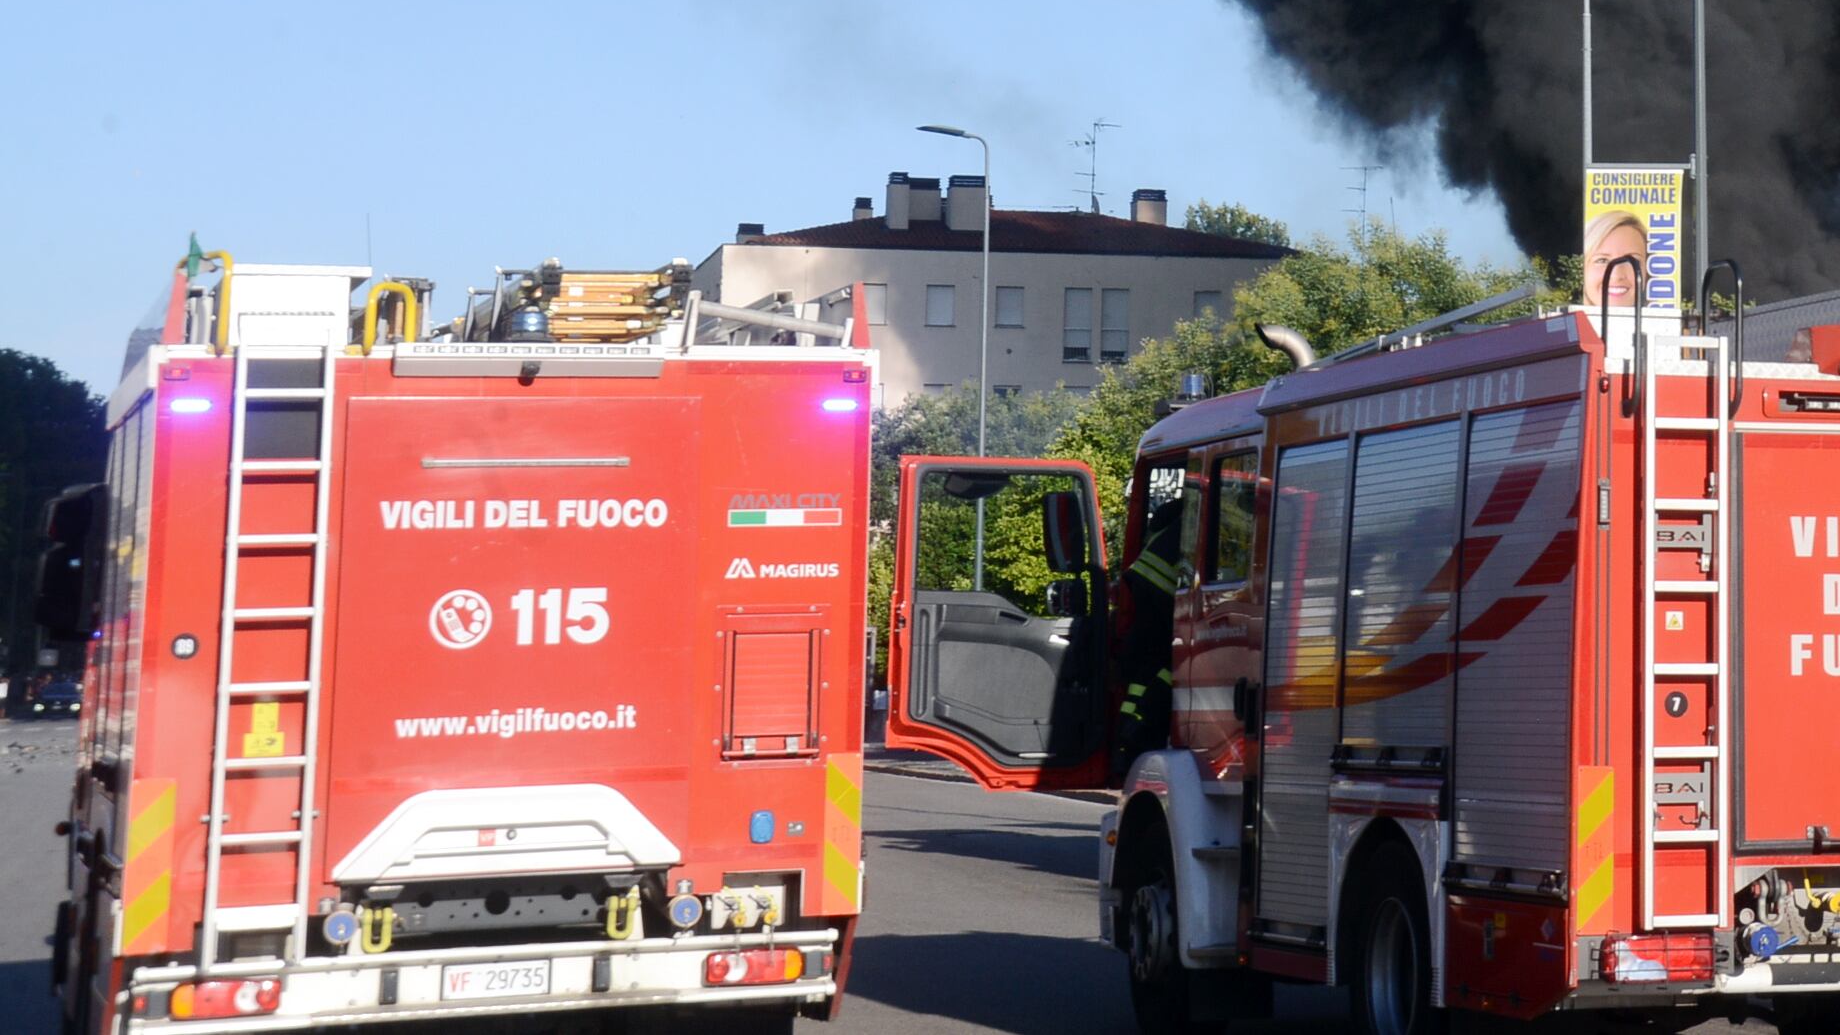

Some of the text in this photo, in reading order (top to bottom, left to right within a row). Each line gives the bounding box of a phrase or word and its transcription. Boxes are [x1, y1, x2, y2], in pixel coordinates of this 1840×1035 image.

[1593, 173, 1676, 186] CONSIGLIERE
[1591, 187, 1676, 205] COMUNALE
[1398, 385, 1438, 422] DEL
[1453, 369, 1526, 412] FUOCO
[728, 492, 843, 510] MAXI CITY
[380, 498, 668, 530] VIGILI DEL FUOCO
[1656, 530, 1705, 542] BAI
[759, 563, 839, 578] MAGIRUS
[510, 586, 610, 645] 115
[1672, 696, 1681, 712] 7
[395, 705, 637, 738] www.vigilfuoco.it
[1654, 782, 1704, 794] BAI
[449, 966, 545, 993] VF 29735
